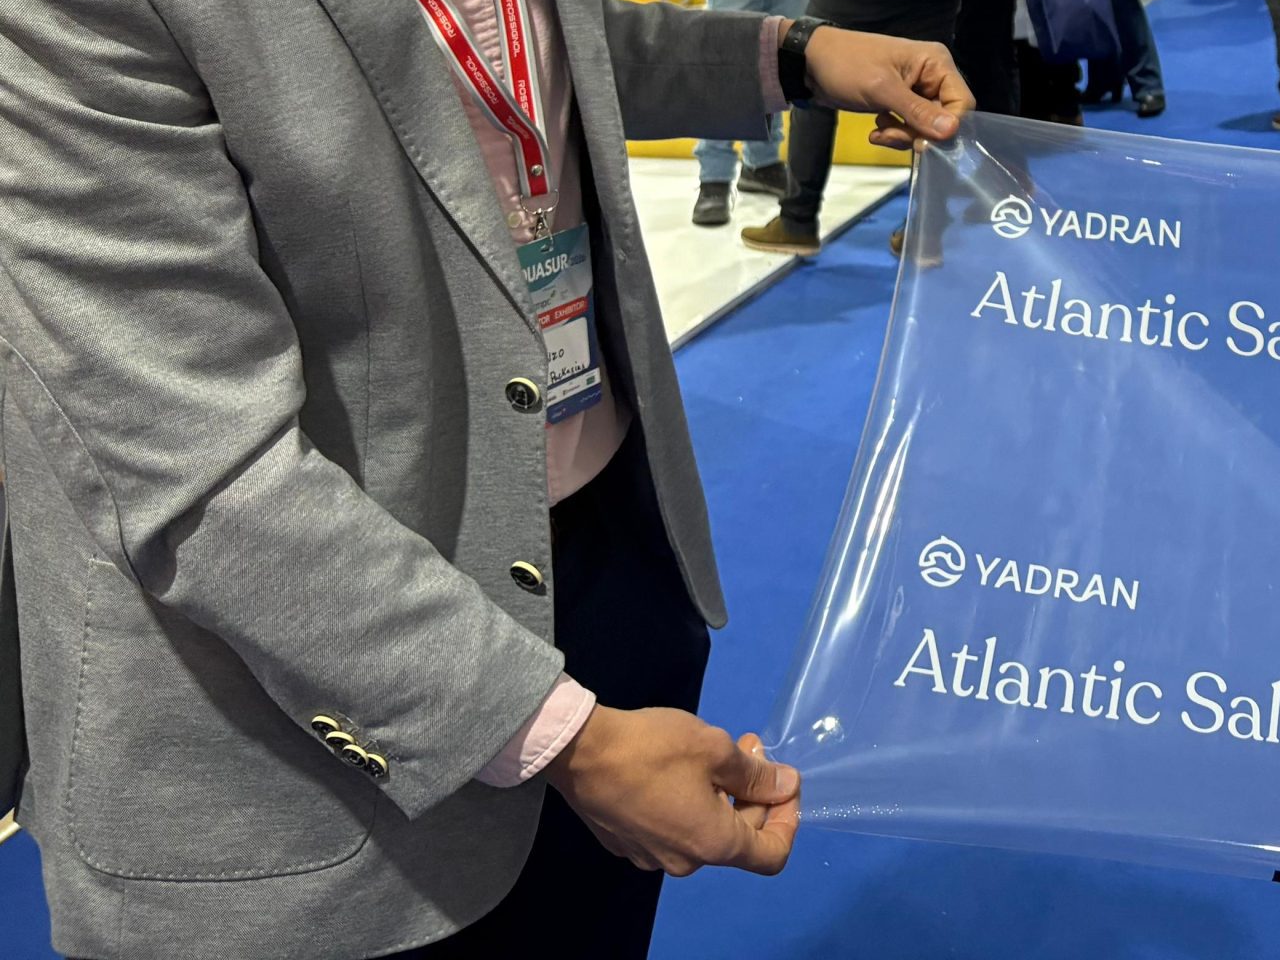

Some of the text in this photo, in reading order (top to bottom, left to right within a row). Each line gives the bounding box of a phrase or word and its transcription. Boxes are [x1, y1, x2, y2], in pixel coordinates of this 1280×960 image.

[506, 0, 521, 58] ROSSIGNOL
[467, 55, 499, 104] ROSSIGNOL
[1040, 207, 1182, 249] YADRAN
[523, 254, 568, 283] UASUR
[970, 271, 1210, 352] Atlantic
[975, 553, 1140, 611] YADRAN
[894, 628, 1163, 726] Atlantic
